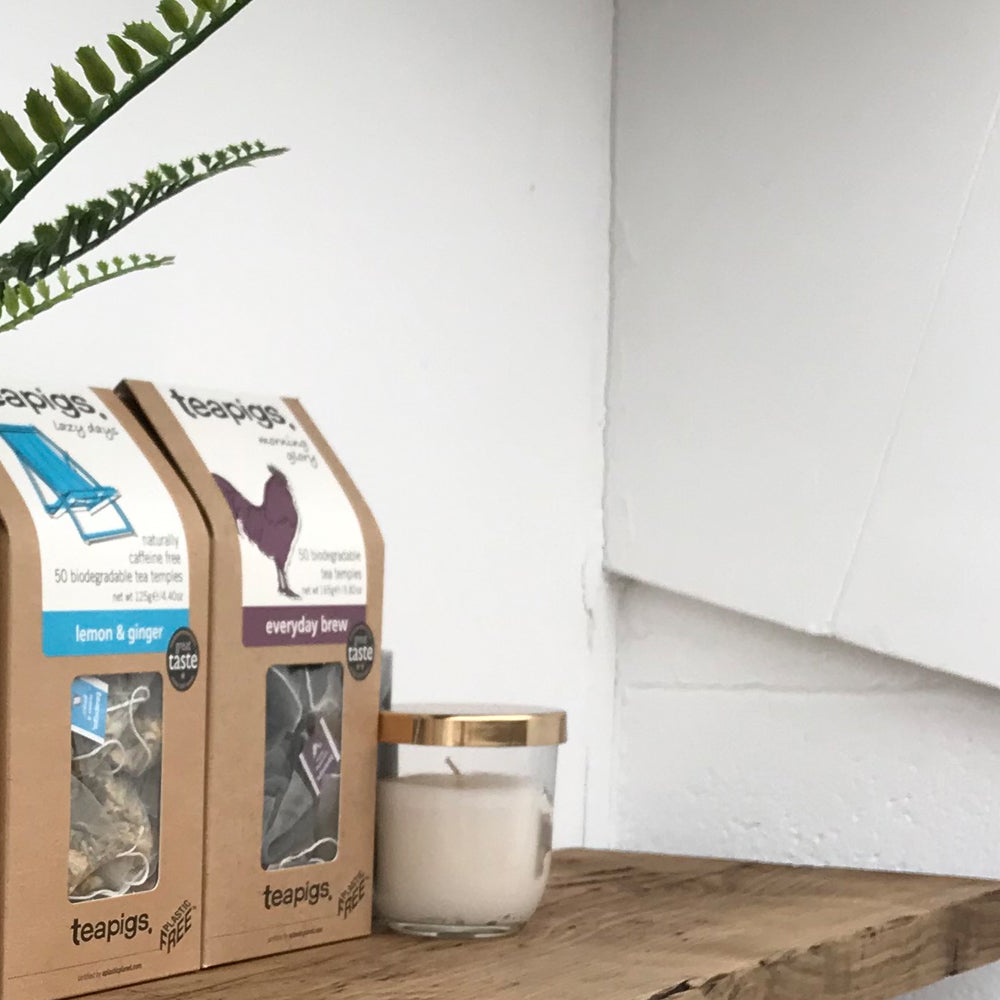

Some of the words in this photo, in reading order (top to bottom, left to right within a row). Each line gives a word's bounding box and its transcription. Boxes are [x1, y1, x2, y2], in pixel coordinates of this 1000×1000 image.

[169, 388, 296, 431] teapigs.
[53, 420, 86, 438] lazy
[88, 421, 120, 441] days
[54, 568, 68, 583] 50
[70, 569, 132, 586] biodegradable
[135, 570, 148, 583] tea
[151, 570, 183, 585] temples
[75, 624, 113, 642] lemon
[116, 624, 125, 641] &
[128, 623, 164, 645] ginger
[265, 615, 319, 639] everyday
[320, 615, 349, 633] brew
[168, 652, 199, 670] taste
[347, 646, 374, 662] taste
[263, 881, 333, 910] teapigs.
[162, 900, 192, 932] PLASTIC
[71, 913, 153, 946] teapigs.
[160, 908, 193, 954] FREE
